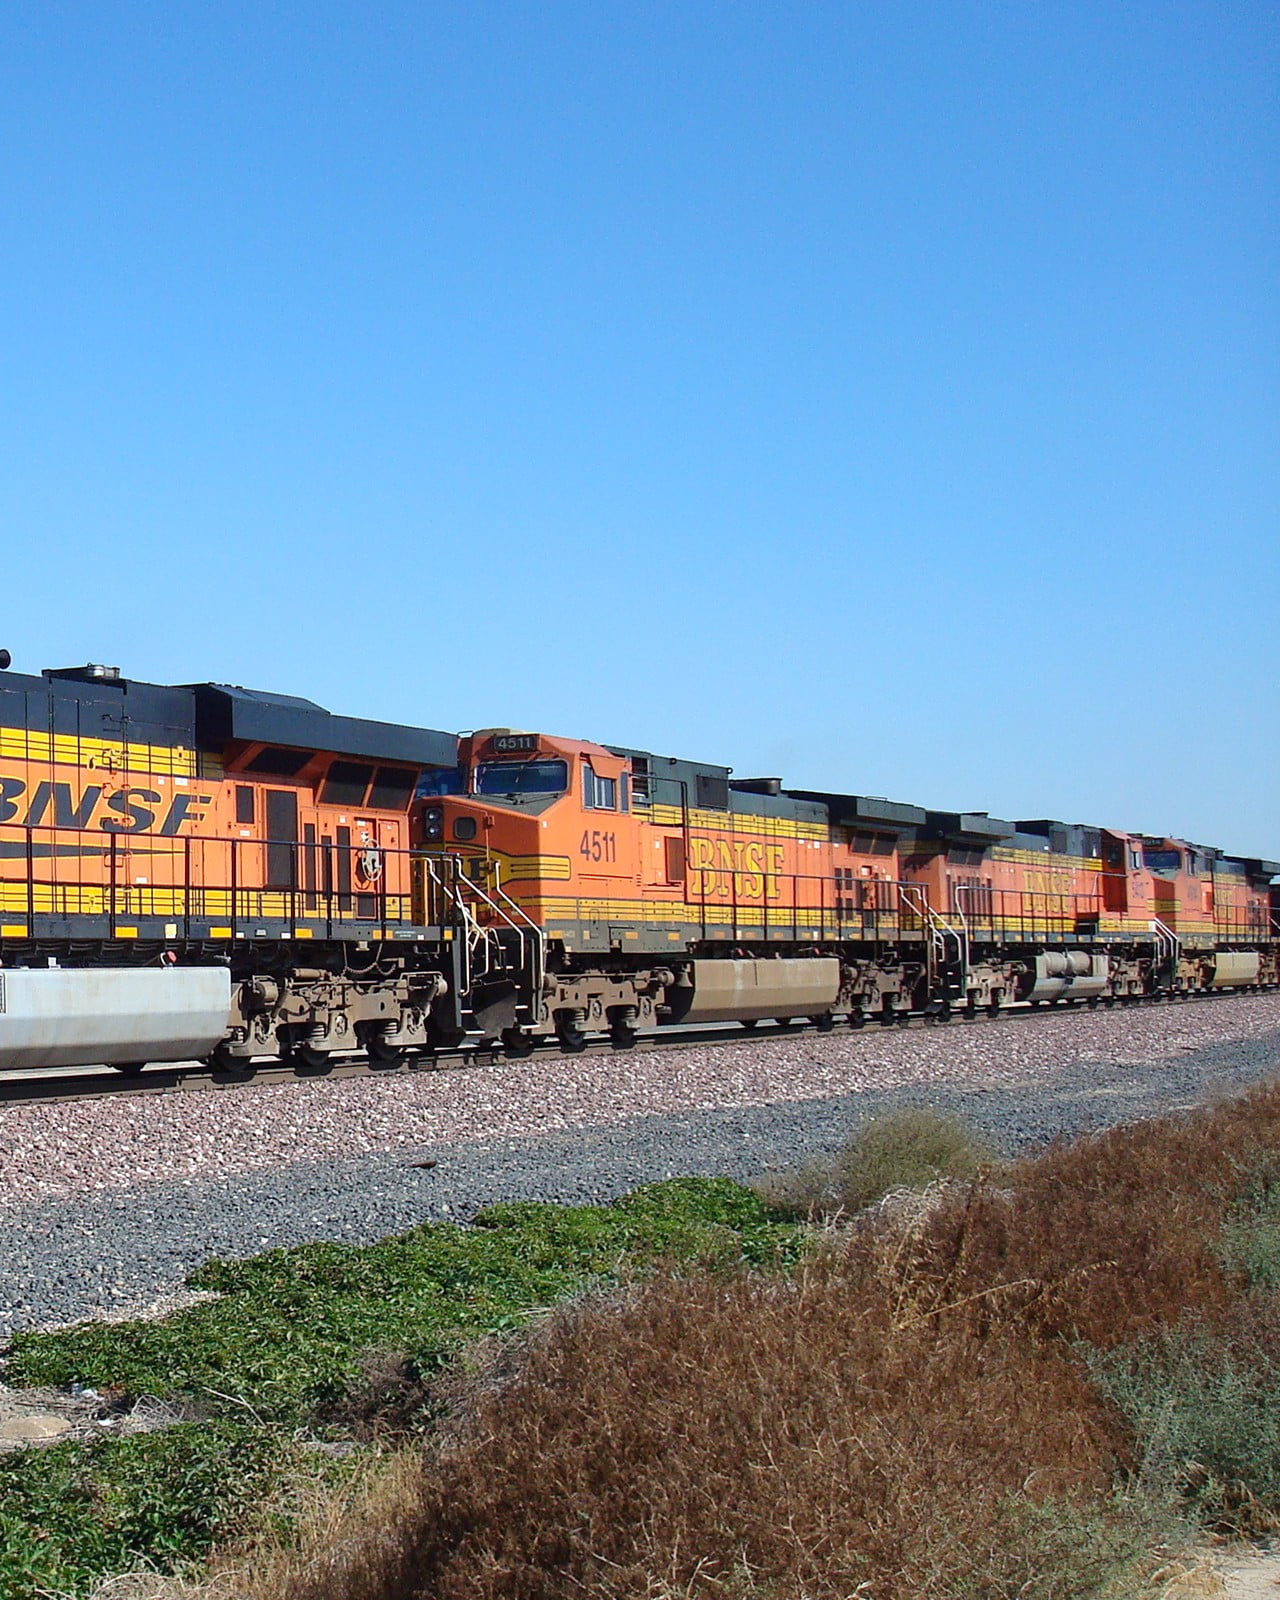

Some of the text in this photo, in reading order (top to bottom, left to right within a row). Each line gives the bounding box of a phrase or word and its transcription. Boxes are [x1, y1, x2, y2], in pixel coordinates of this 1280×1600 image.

[498, 737, 531, 749] 4511
[580, 830, 616, 863] 4511
[690, 836, 784, 899] BNSF
